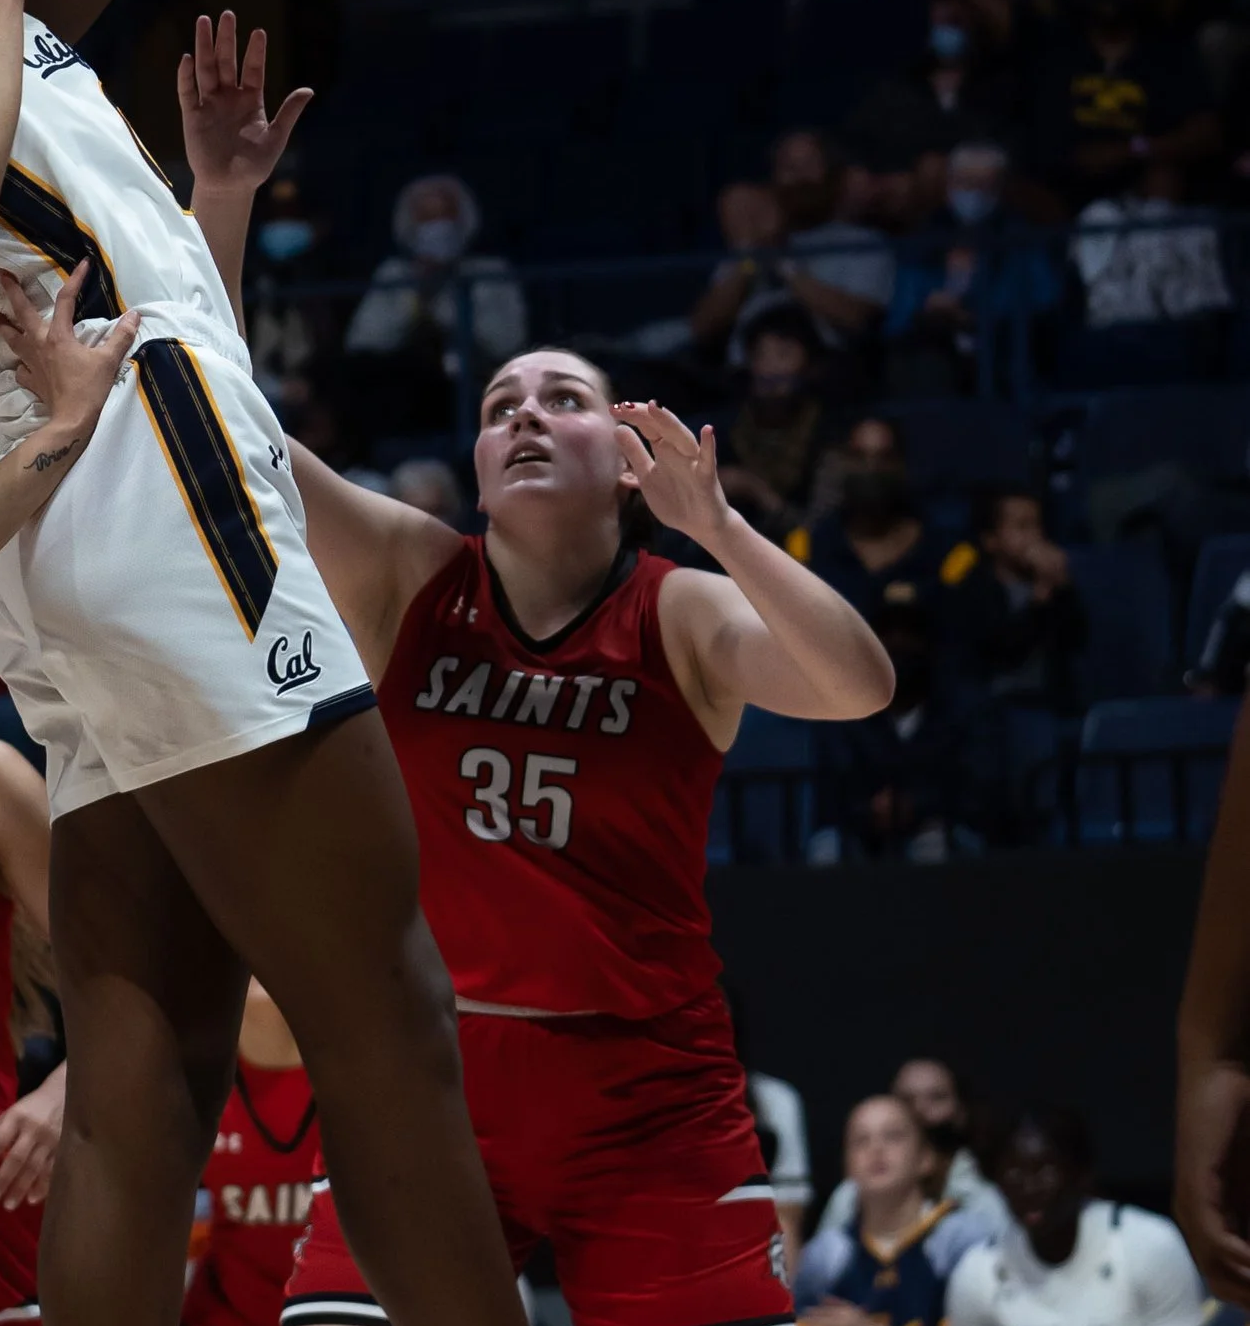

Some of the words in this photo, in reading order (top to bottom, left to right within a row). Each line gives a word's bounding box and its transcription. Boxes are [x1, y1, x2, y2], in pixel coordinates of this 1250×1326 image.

[267, 630, 321, 696] Cal
[414, 655, 639, 736] SAINTS
[458, 745, 579, 851] 35
